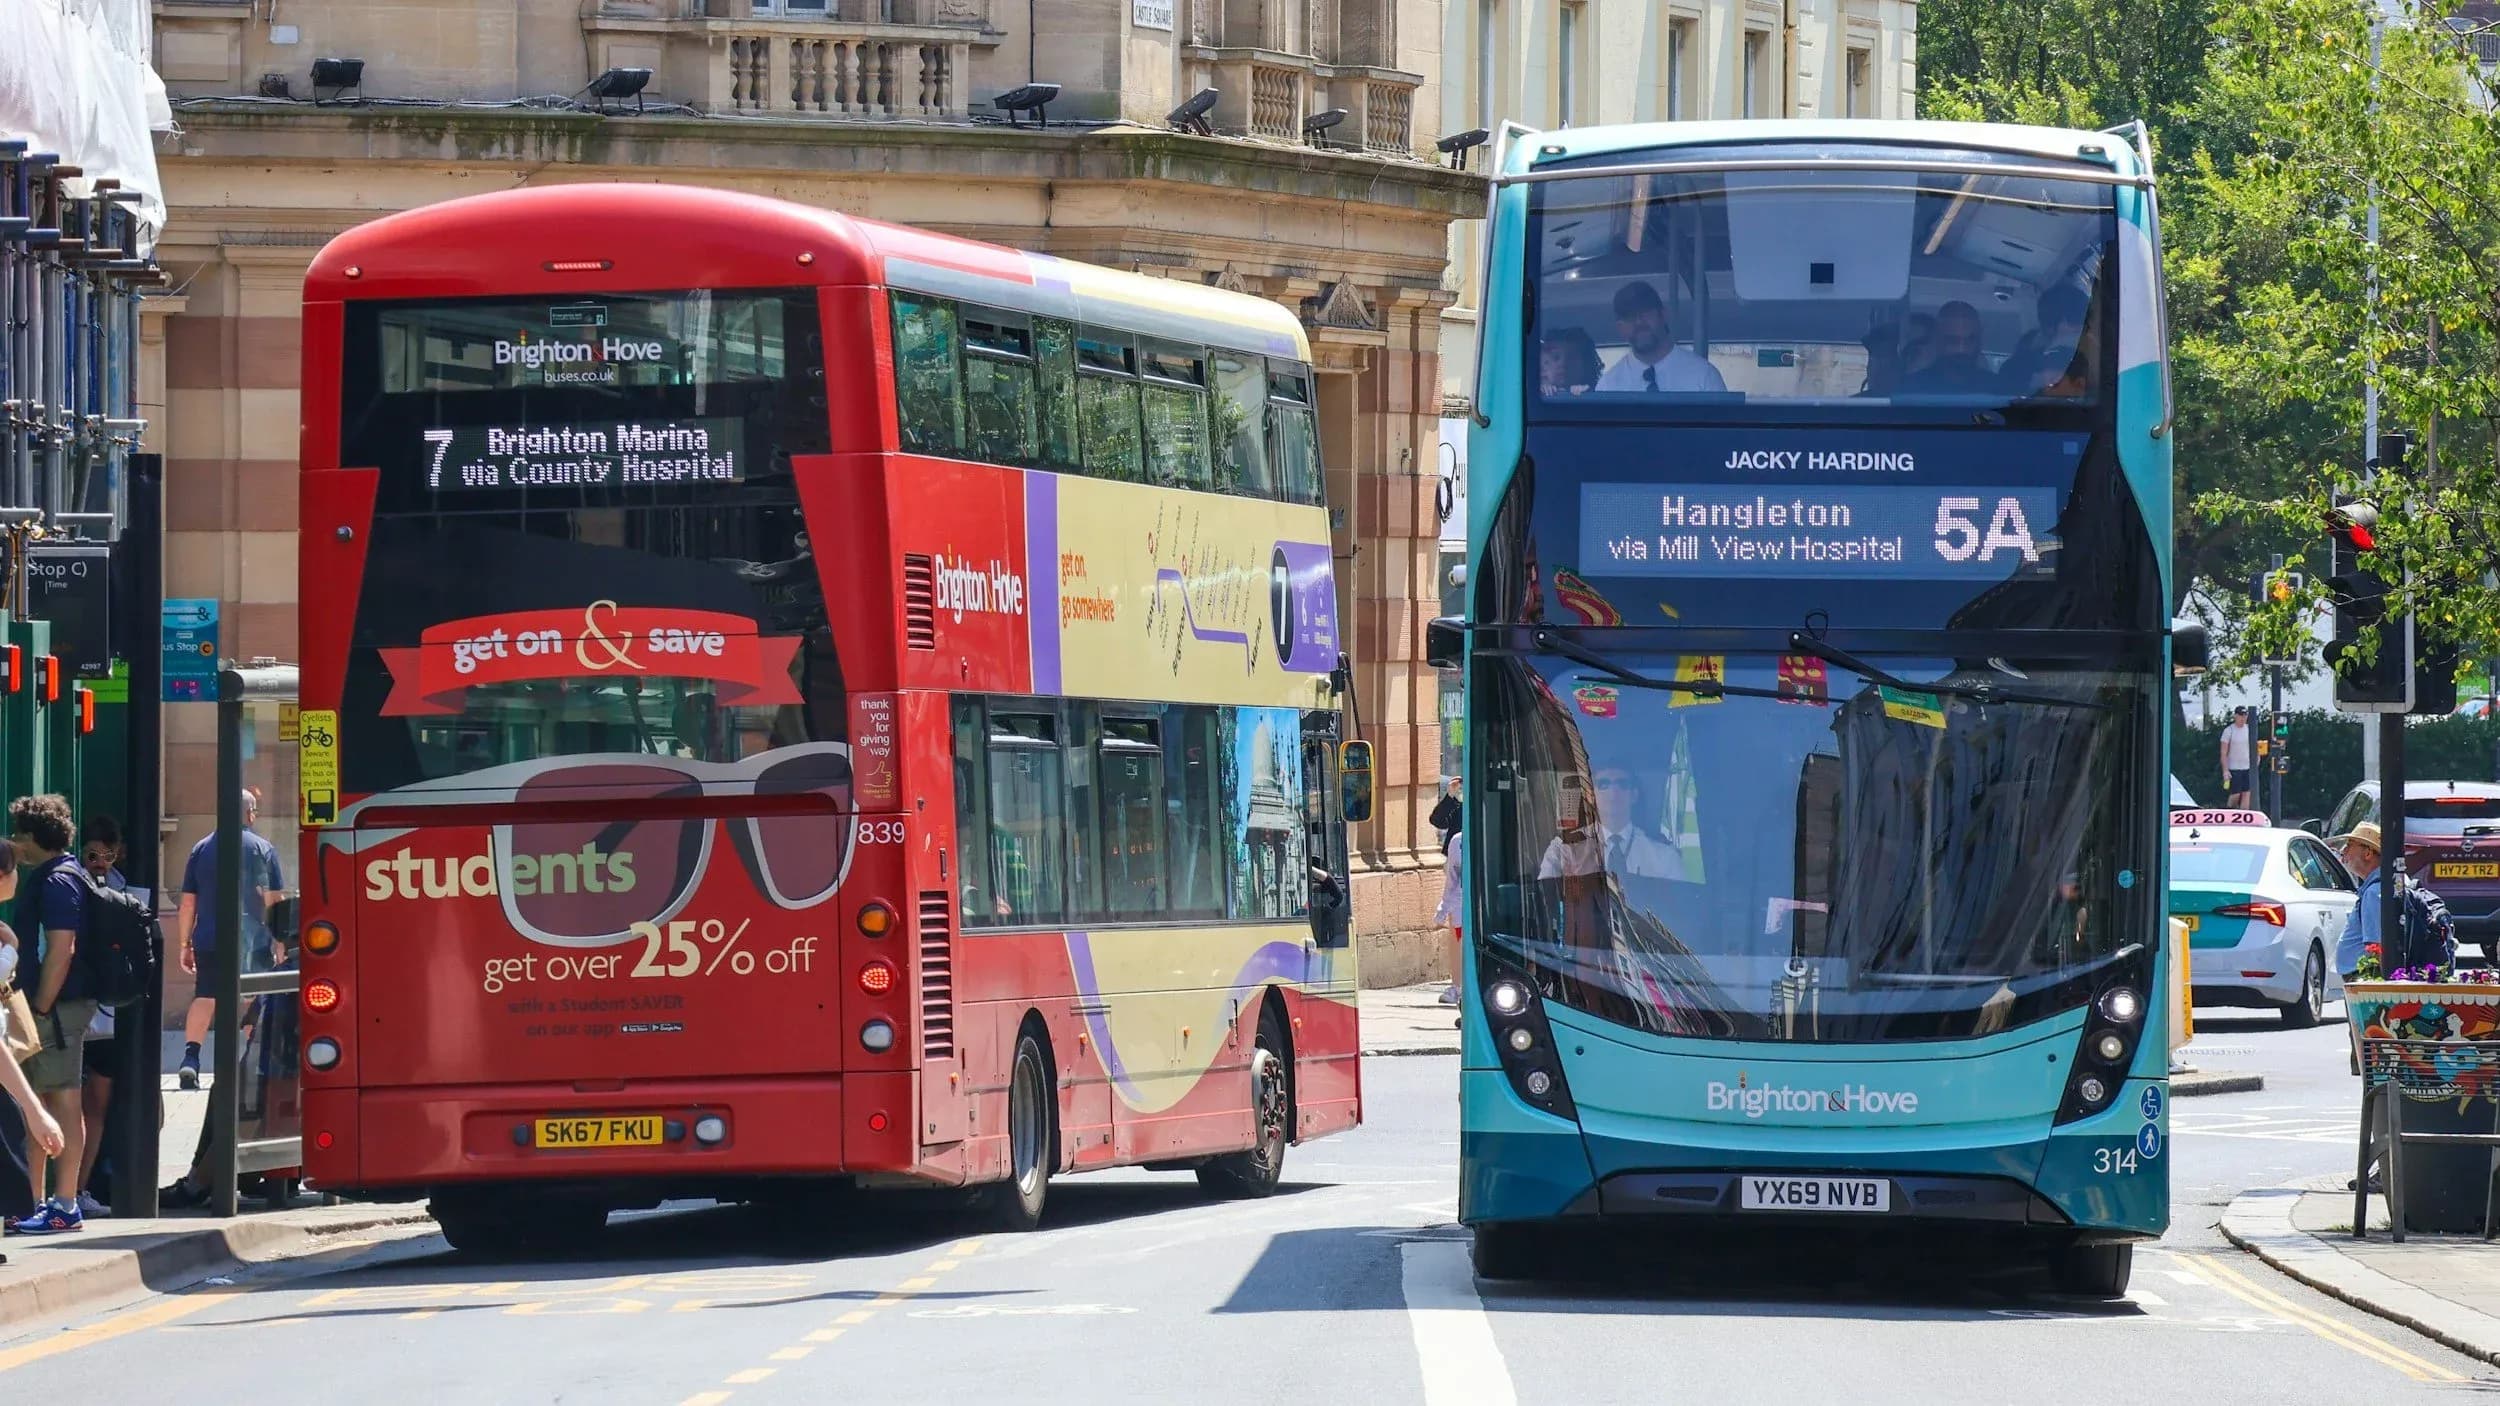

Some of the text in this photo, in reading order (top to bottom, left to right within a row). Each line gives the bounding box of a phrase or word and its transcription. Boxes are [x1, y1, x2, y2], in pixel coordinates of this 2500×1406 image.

[545, 368, 614, 383] buses.co.uk
[488, 424, 708, 455] Brighton Marina
[423, 429, 453, 487] 7
[462, 452, 734, 486] via County Hospital
[1725, 451, 1914, 471] JACKY HARDING
[1662, 496, 1850, 528] Hangleton
[1934, 497, 2039, 561] 5A
[1608, 535, 1902, 561] via Mill View Hospital
[71, 561, 88, 577] C)
[1061, 548, 1073, 586] get
[1062, 587, 1115, 628] go somewhere
[162, 643, 174, 651] us
[176, 642, 198, 653] Stop
[453, 600, 725, 674] get on & save
[861, 699, 889, 710] thank
[302, 713, 332, 724] Cyclists
[870, 712, 889, 723] you
[876, 722, 889, 732] for
[860, 734, 890, 747] giving
[870, 748, 890, 758] way
[2174, 813, 2254, 824] 20 20 20
[858, 822, 905, 844] 839
[365, 834, 637, 901] students
[2440, 865, 2493, 875] HY72 TRZ
[484, 918, 818, 993] get over 25% off
[560, 996, 625, 1012] Student
[631, 994, 683, 1010] SAVER
[545, 1119, 653, 1142] SK67 FKU
[2093, 1148, 2138, 1176] 314
[1753, 1180, 1877, 1206] YX69 NVB
